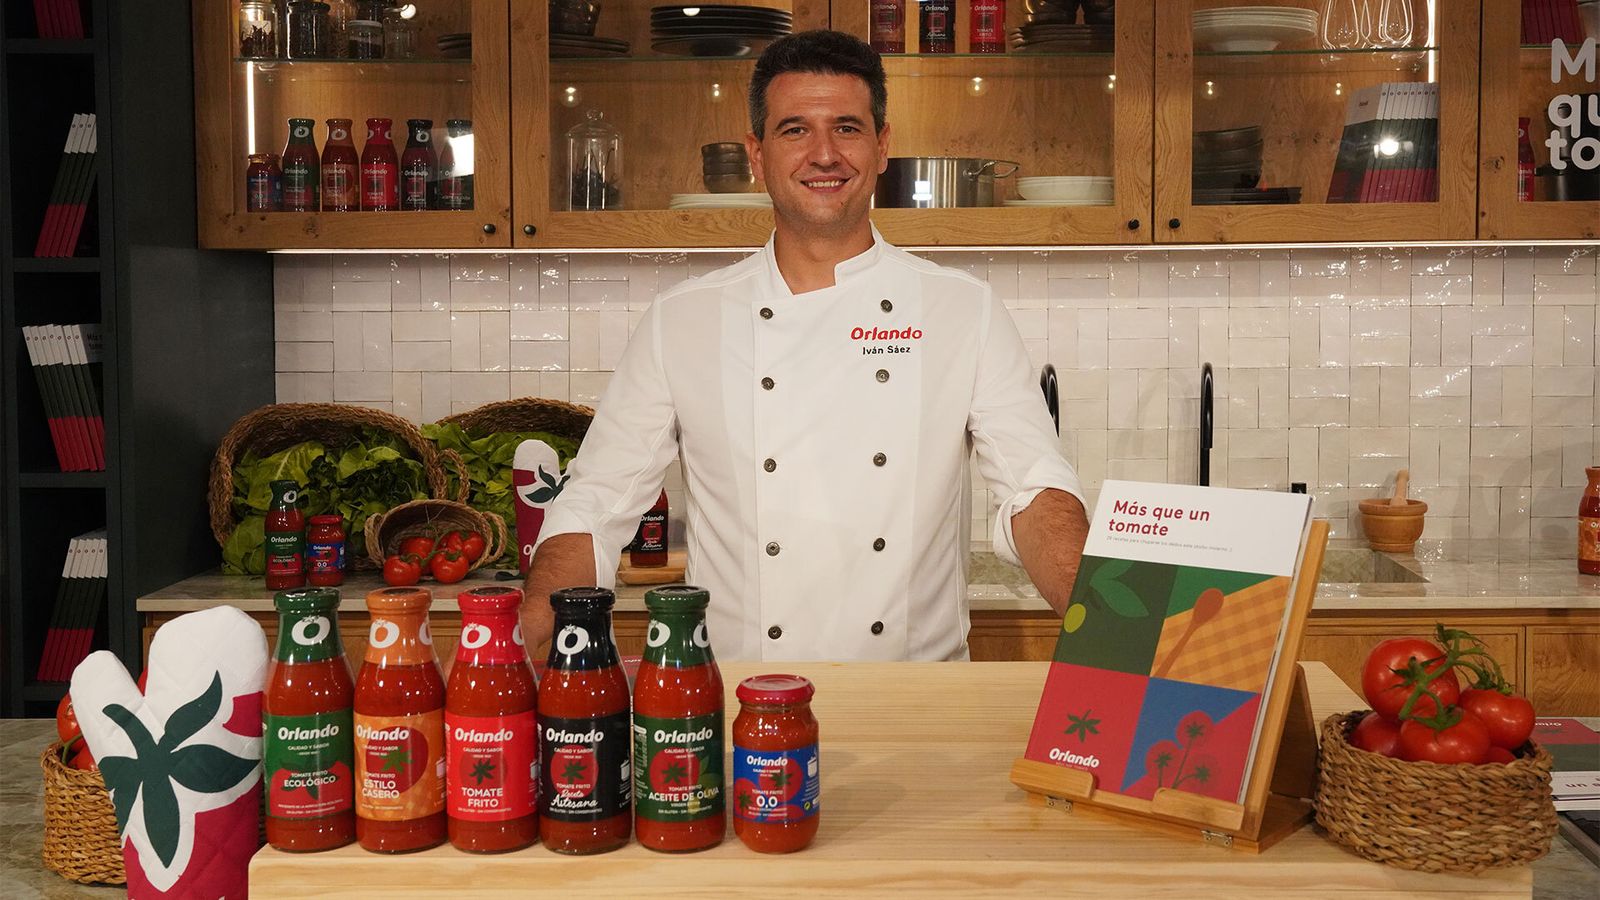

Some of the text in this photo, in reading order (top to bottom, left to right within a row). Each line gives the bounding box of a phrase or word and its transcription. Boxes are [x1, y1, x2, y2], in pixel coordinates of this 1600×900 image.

[851, 326, 923, 341] Orlando
[862, 344, 911, 355] Iván Sáez
[1113, 500, 1210, 521] Más que un
[1108, 519, 1169, 536] tomate
[278, 723, 339, 741] Orlando
[356, 724, 410, 741] Orlando
[455, 728, 514, 743] Orlando
[546, 728, 605, 744] Orlando
[653, 727, 714, 744] Orlando
[746, 755, 788, 767] Orlando
[1049, 747, 1100, 769] Orlando
[284, 774, 336, 788] ECOLÓGICO
[364, 779, 396, 790] ESTILO
[362, 788, 400, 799] CASERO
[461, 787, 503, 797] TOMATE
[648, 787, 719, 802] ACEITE DE OLIVA
[468, 799, 499, 808] FRITO
[550, 794, 598, 808] Artesana
